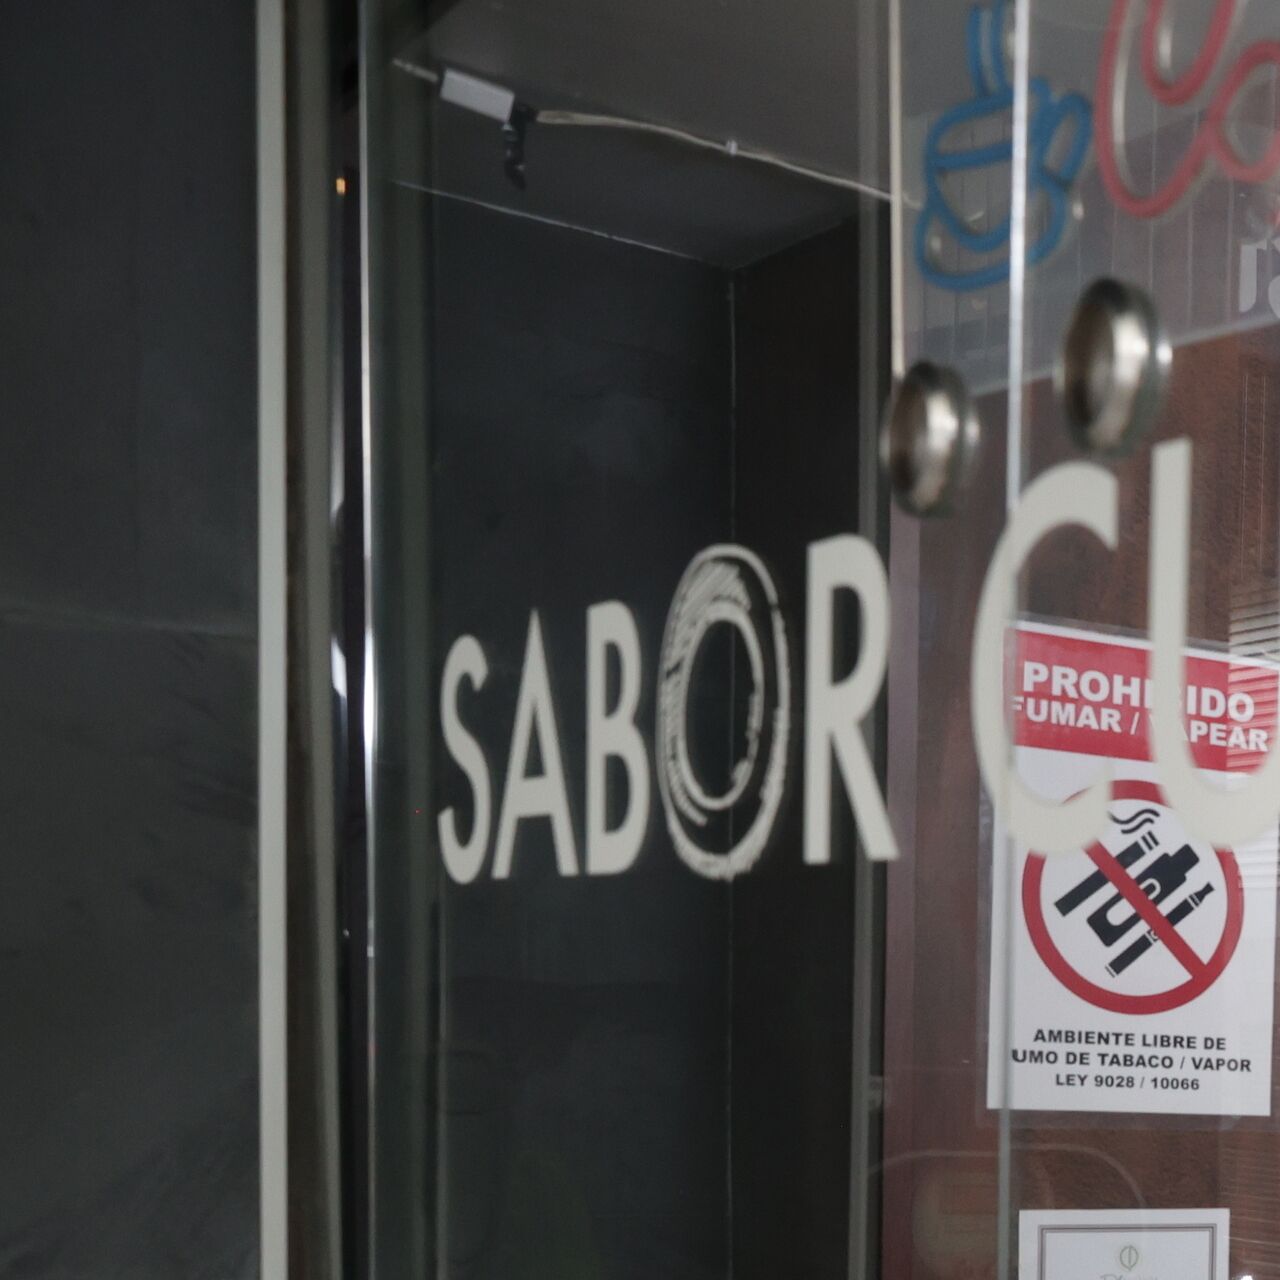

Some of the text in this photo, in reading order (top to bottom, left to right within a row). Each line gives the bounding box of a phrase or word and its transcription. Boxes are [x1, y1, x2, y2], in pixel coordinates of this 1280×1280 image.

[1023, 660, 1255, 722] PROHIIDO
[437, 532, 900, 884] SABOR
[1033, 1029, 1226, 1050] AMBIENTE LIBRE DE
[1011, 1049, 1058, 1065] UMO
[1065, 1052, 1090, 1066] DE
[1098, 1053, 1173, 1069] TABACO
[1191, 1057, 1251, 1072] VAPOR
[1056, 1073, 1087, 1087] LEY
[1094, 1075, 1134, 1088] 9028
[1151, 1077, 1199, 1090] 10066
